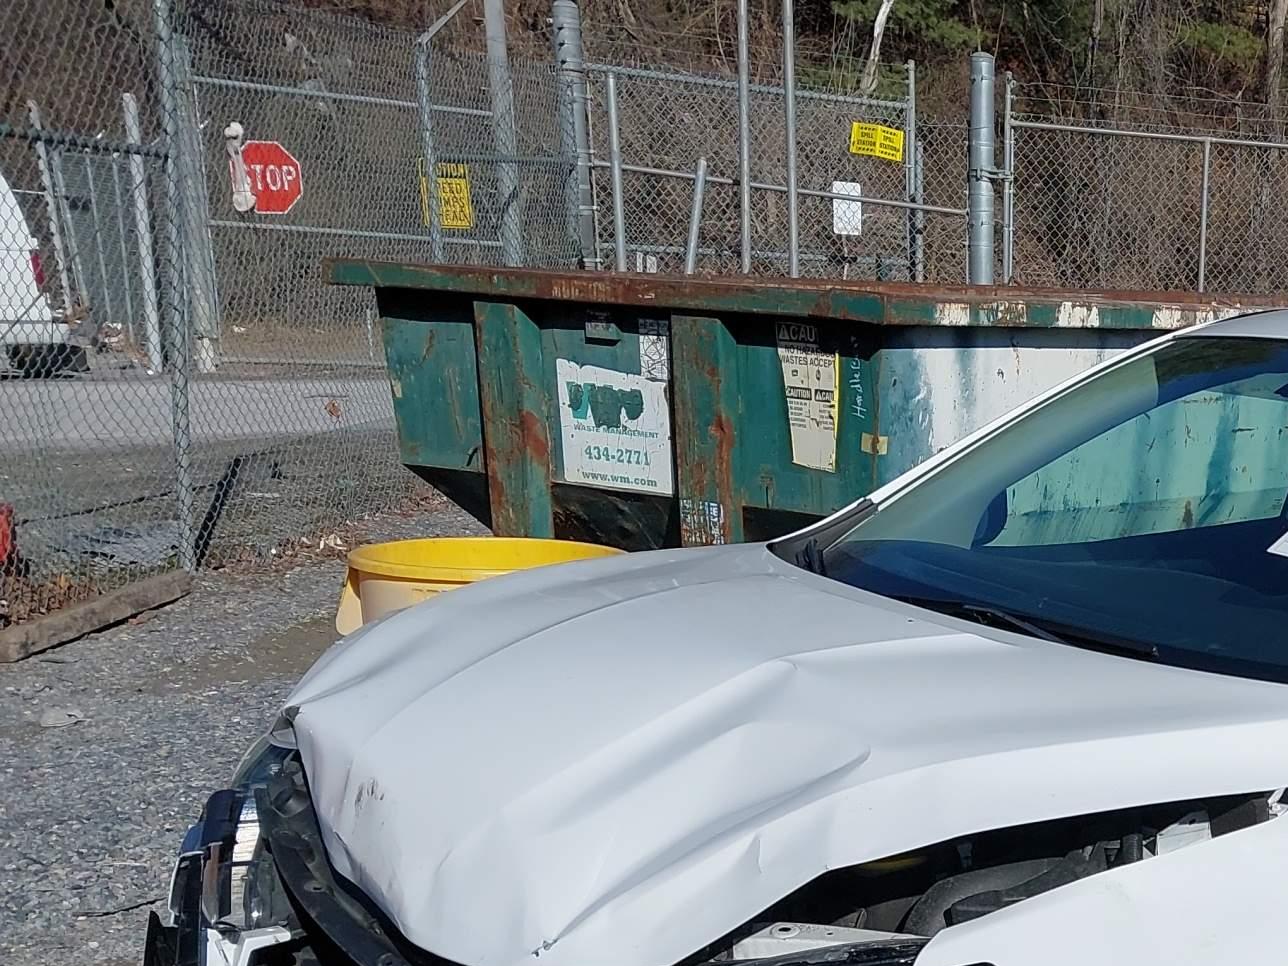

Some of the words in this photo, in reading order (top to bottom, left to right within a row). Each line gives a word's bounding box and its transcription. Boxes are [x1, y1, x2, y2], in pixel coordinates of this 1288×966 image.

[789, 326, 817, 343] CAU
[784, 344, 796, 355] NO
[809, 358, 834, 369] ACCEP
[822, 392, 834, 401] CAU
[573, 423, 601, 433] WASTE
[602, 427, 659, 439] MANAGEMENT
[584, 445, 651, 466] 434-2771
[581, 471, 658, 487] www.wm.com
